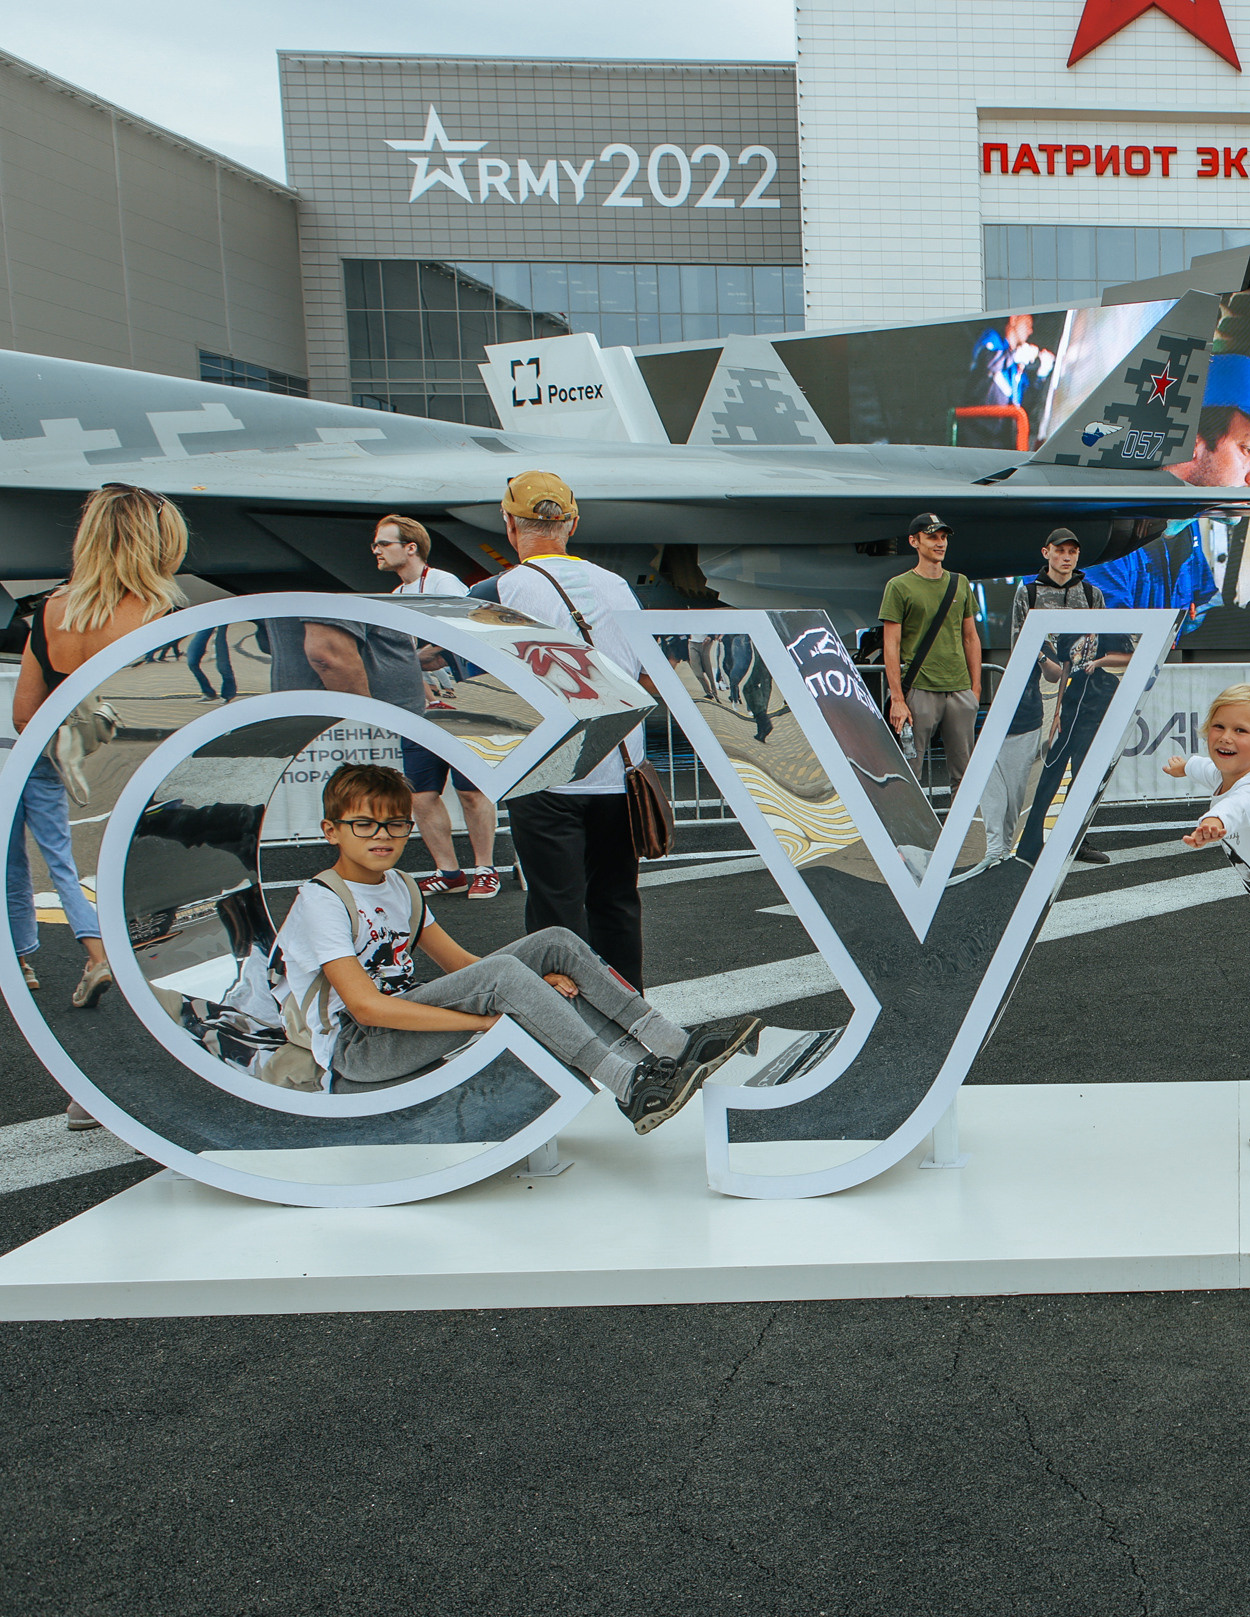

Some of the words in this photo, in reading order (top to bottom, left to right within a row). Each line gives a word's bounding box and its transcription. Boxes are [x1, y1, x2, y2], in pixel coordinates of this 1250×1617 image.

[982, 142, 1178, 176] ПАТРИОТ
[600, 143, 781, 209] 2022
[547, 383, 604, 404] Ростех
[1121, 429, 1166, 460] 057
